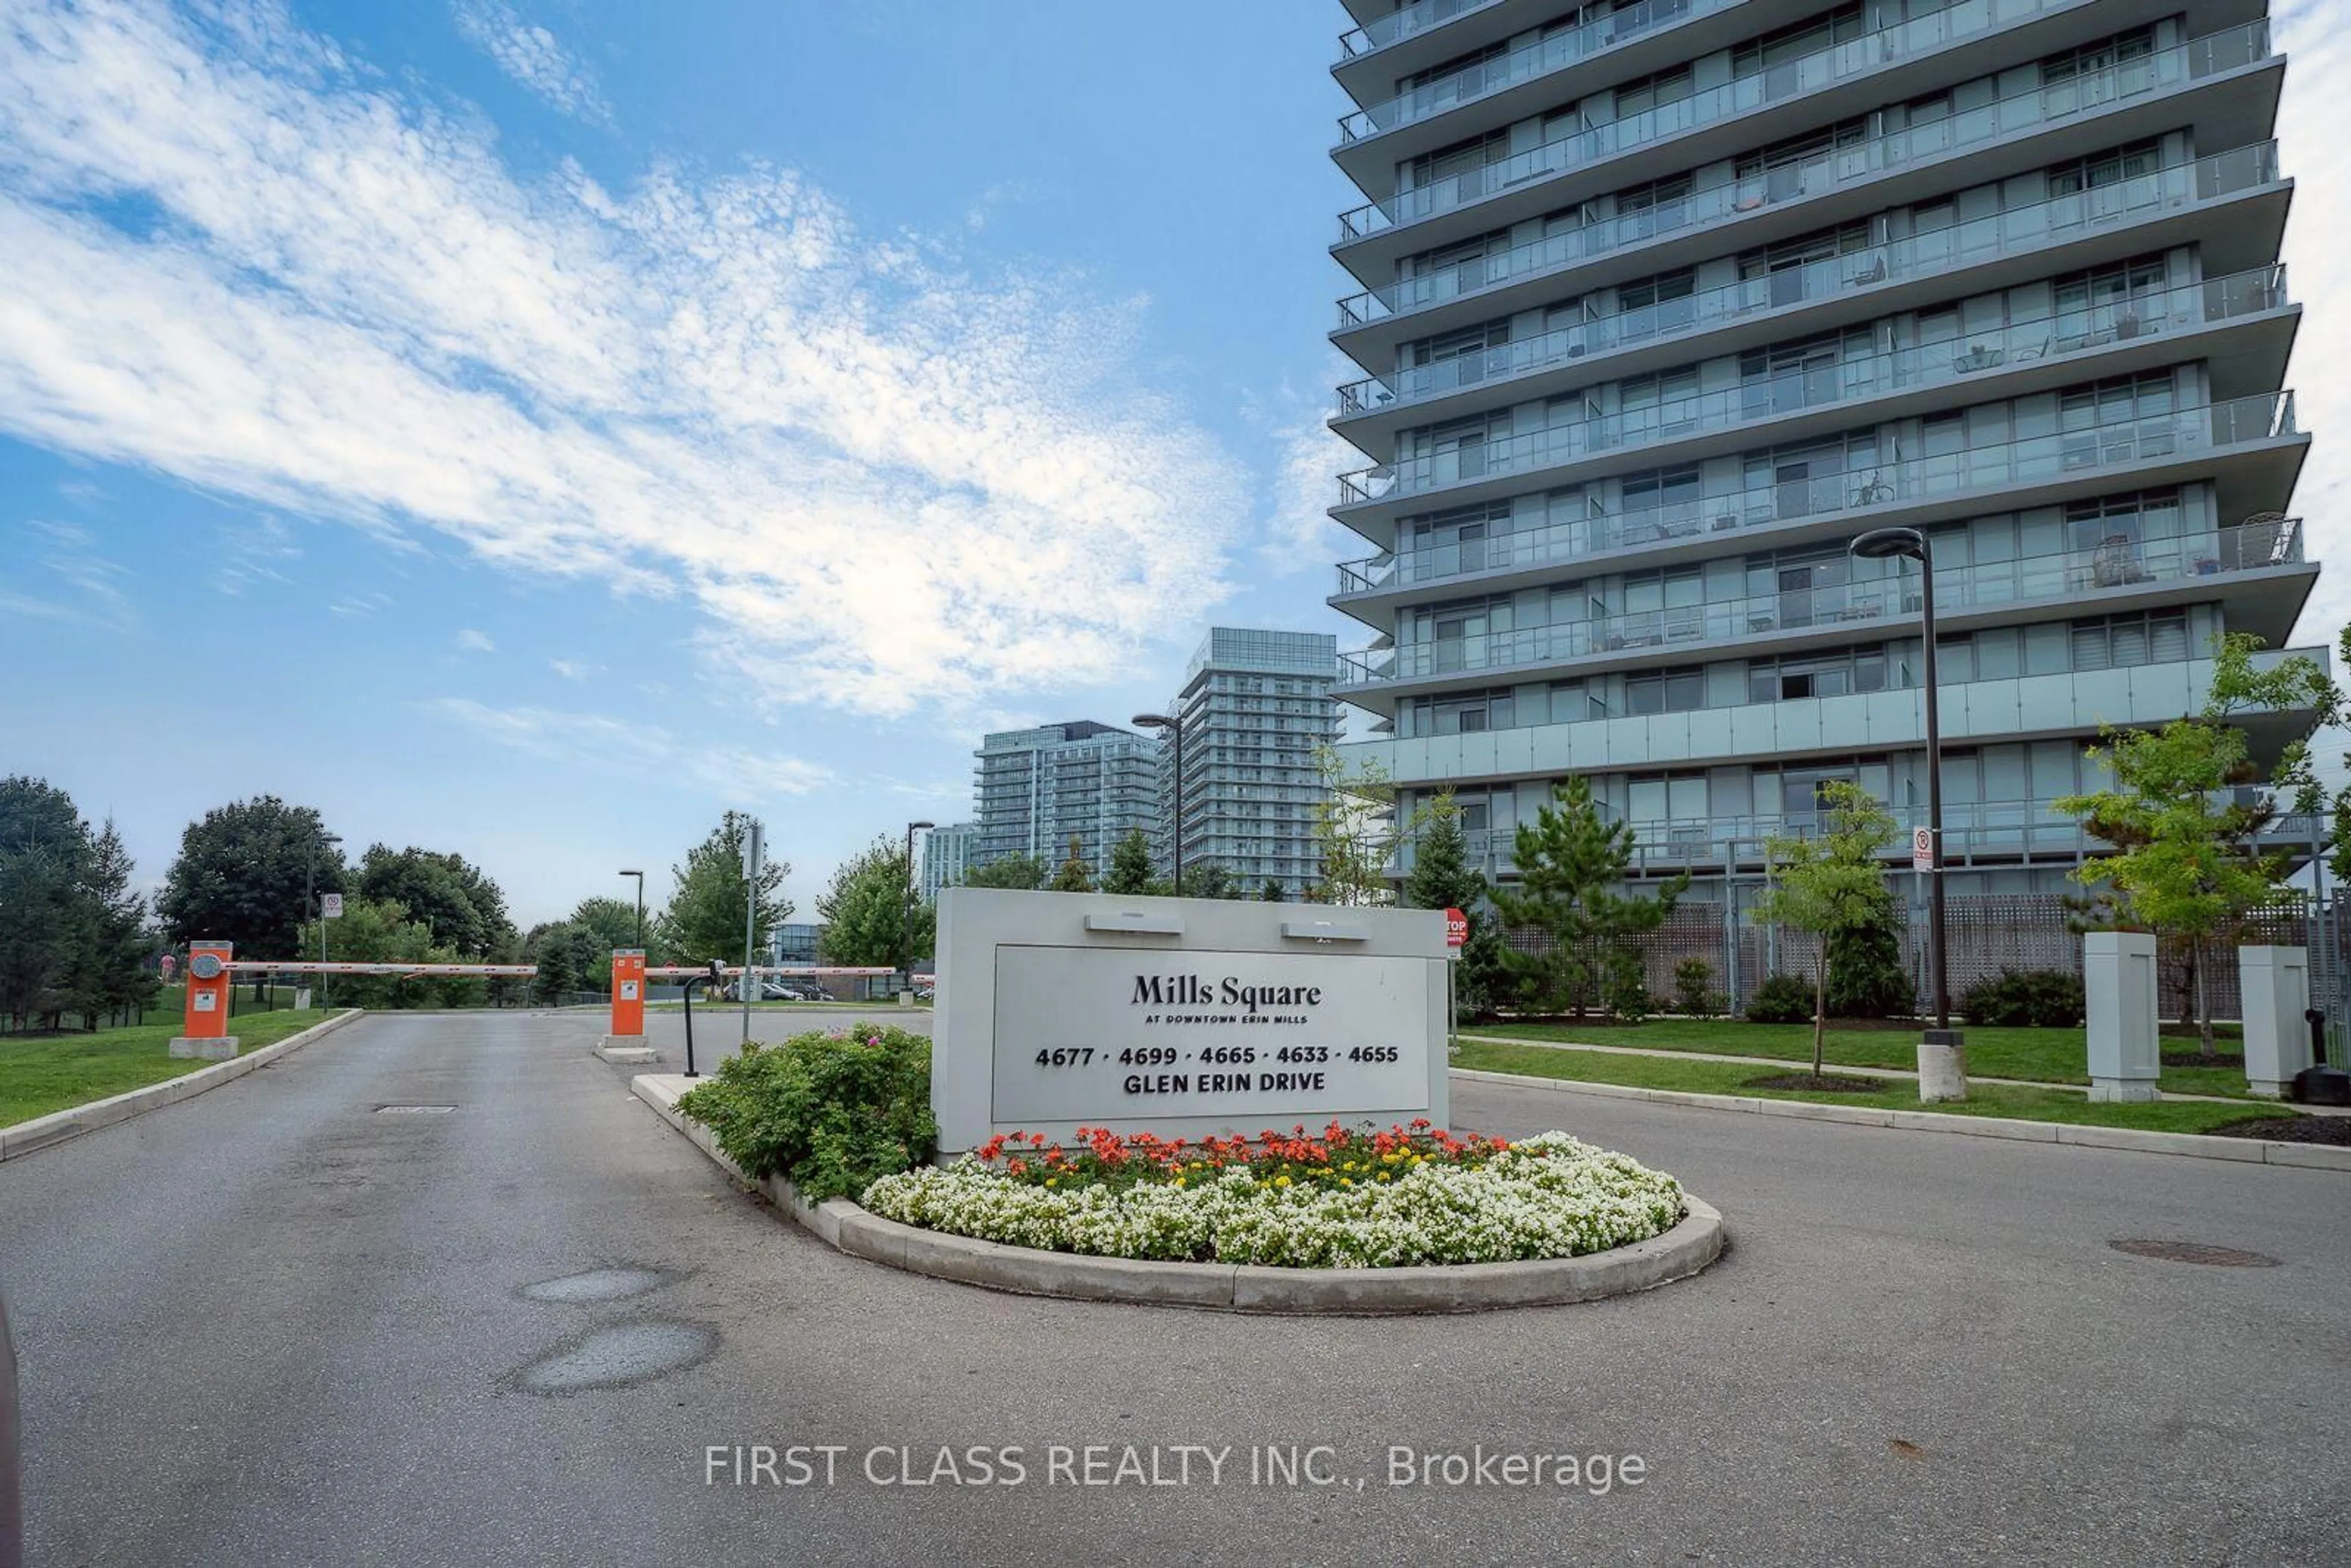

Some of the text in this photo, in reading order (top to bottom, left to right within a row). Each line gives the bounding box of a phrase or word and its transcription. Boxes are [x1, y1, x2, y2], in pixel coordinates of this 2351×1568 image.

[1447, 921, 1466, 931] TOP
[1131, 975, 1322, 1013] Mills Square
[1146, 1015, 1308, 1024] AT DOWNTOWN ERIN MILLS
[1035, 1046, 1398, 1066] 4677 4699 4665 4633 4655
[1124, 1072, 1325, 1093] GLEN ERIN DRIVE
